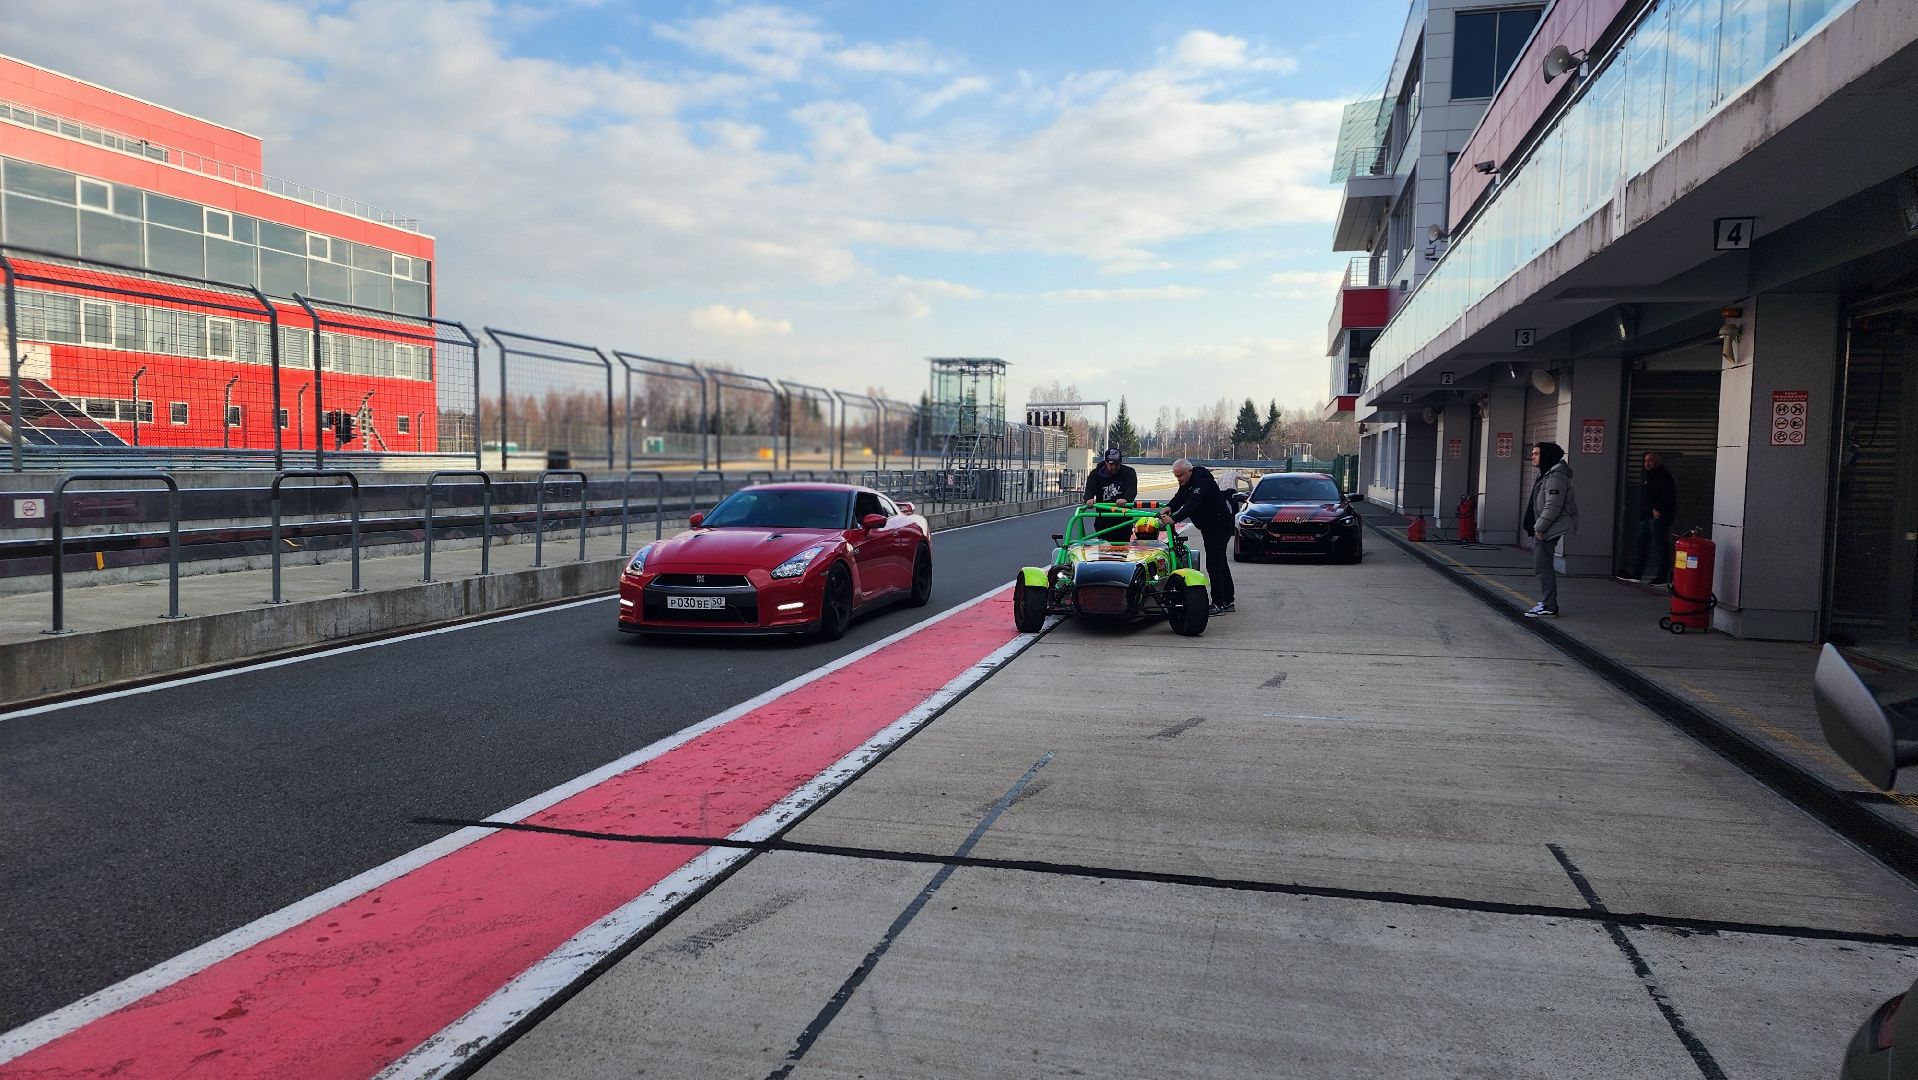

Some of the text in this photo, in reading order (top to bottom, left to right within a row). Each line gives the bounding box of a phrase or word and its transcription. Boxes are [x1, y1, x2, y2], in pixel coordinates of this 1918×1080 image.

[1727, 222, 1742, 246] 4
[1521, 331, 1530, 345] 3
[1445, 375, 1451, 384] 2
[711, 597, 722, 606] 50
